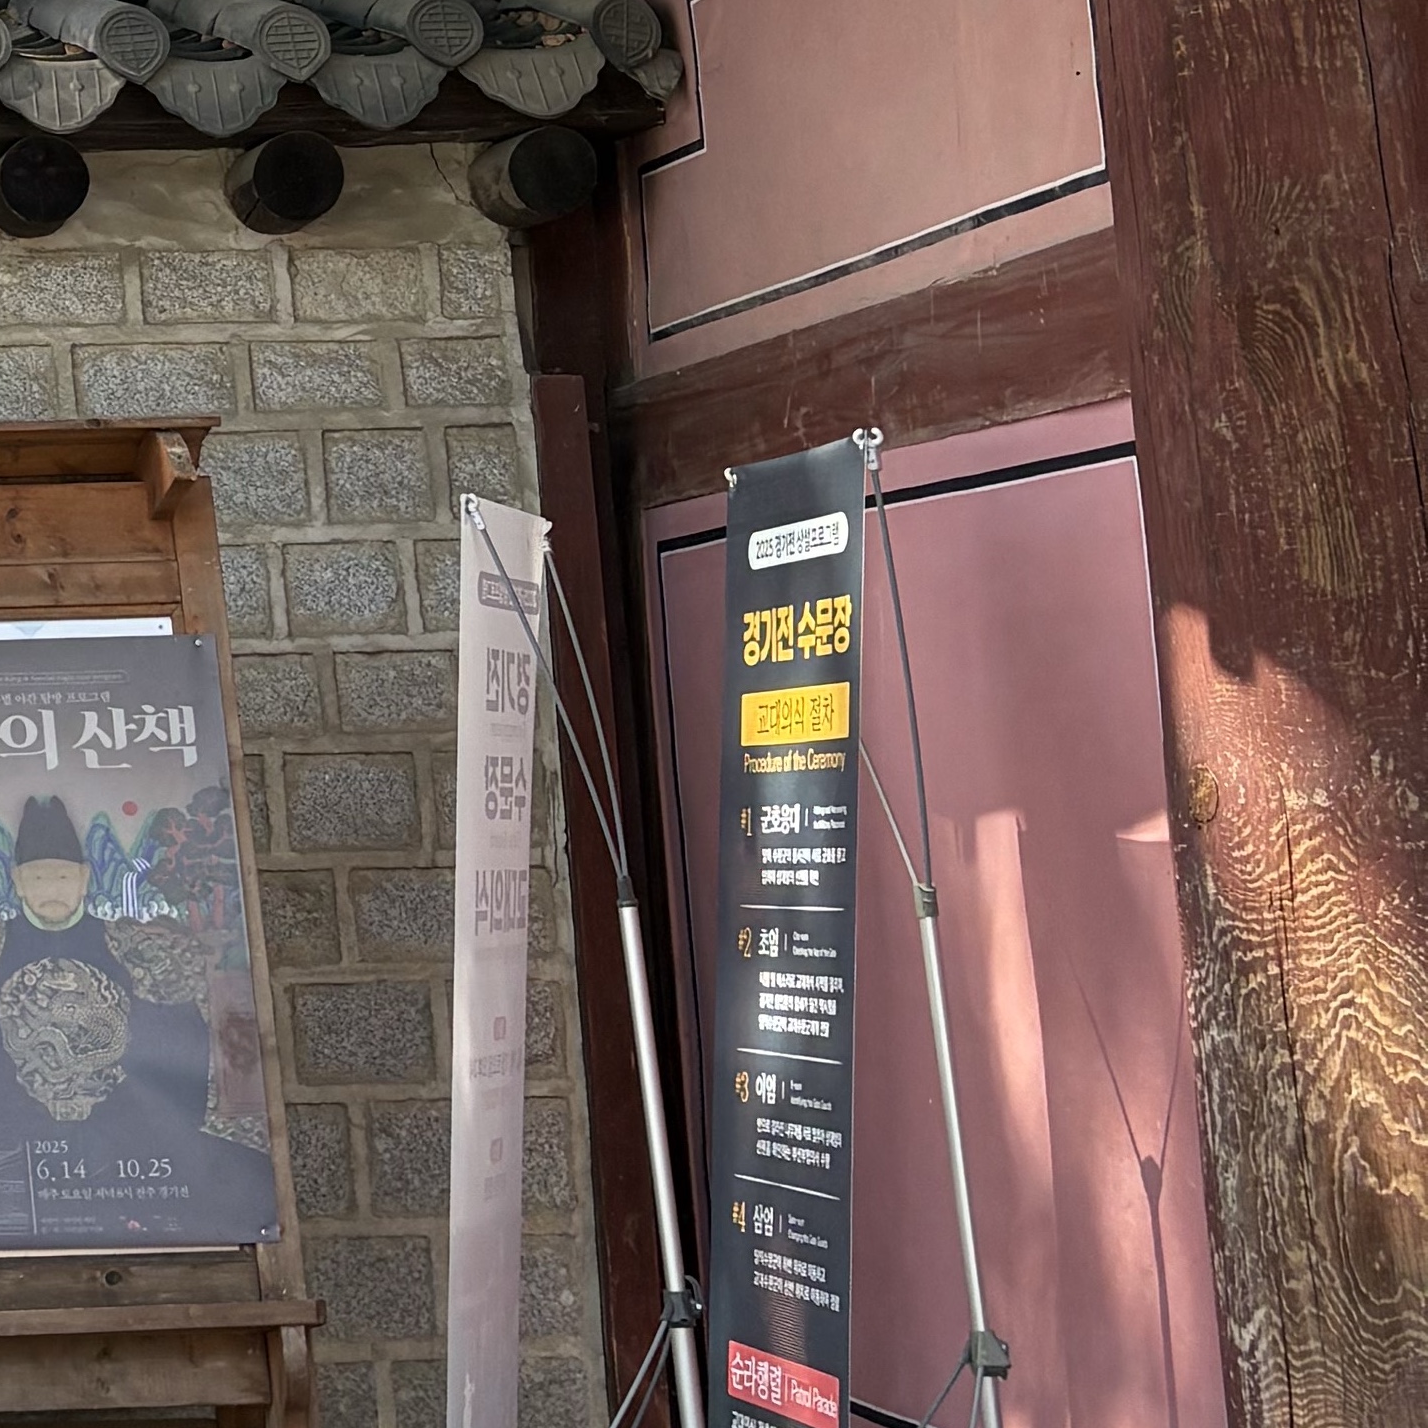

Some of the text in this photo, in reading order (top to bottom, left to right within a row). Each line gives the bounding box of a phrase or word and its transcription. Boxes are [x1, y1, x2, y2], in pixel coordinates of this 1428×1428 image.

[743, 594, 852, 666] 경기전 수문장
[756, 694, 834, 734] 교대의식 절차
[72, 705, 197, 768] 산책
[744, 748, 846, 773] Procedure of the Ceremony
[759, 928, 779, 957] 초엄
[756, 1072, 776, 1104] 이엄
[36, 1141, 68, 1153] 2025
[37, 1159, 171, 1181] 6.14 10.25
[753, 1204, 774, 1236] 삼엄
[730, 1352, 782, 1405] 순라행렬
[791, 1379, 838, 1419] Patrol Parade
